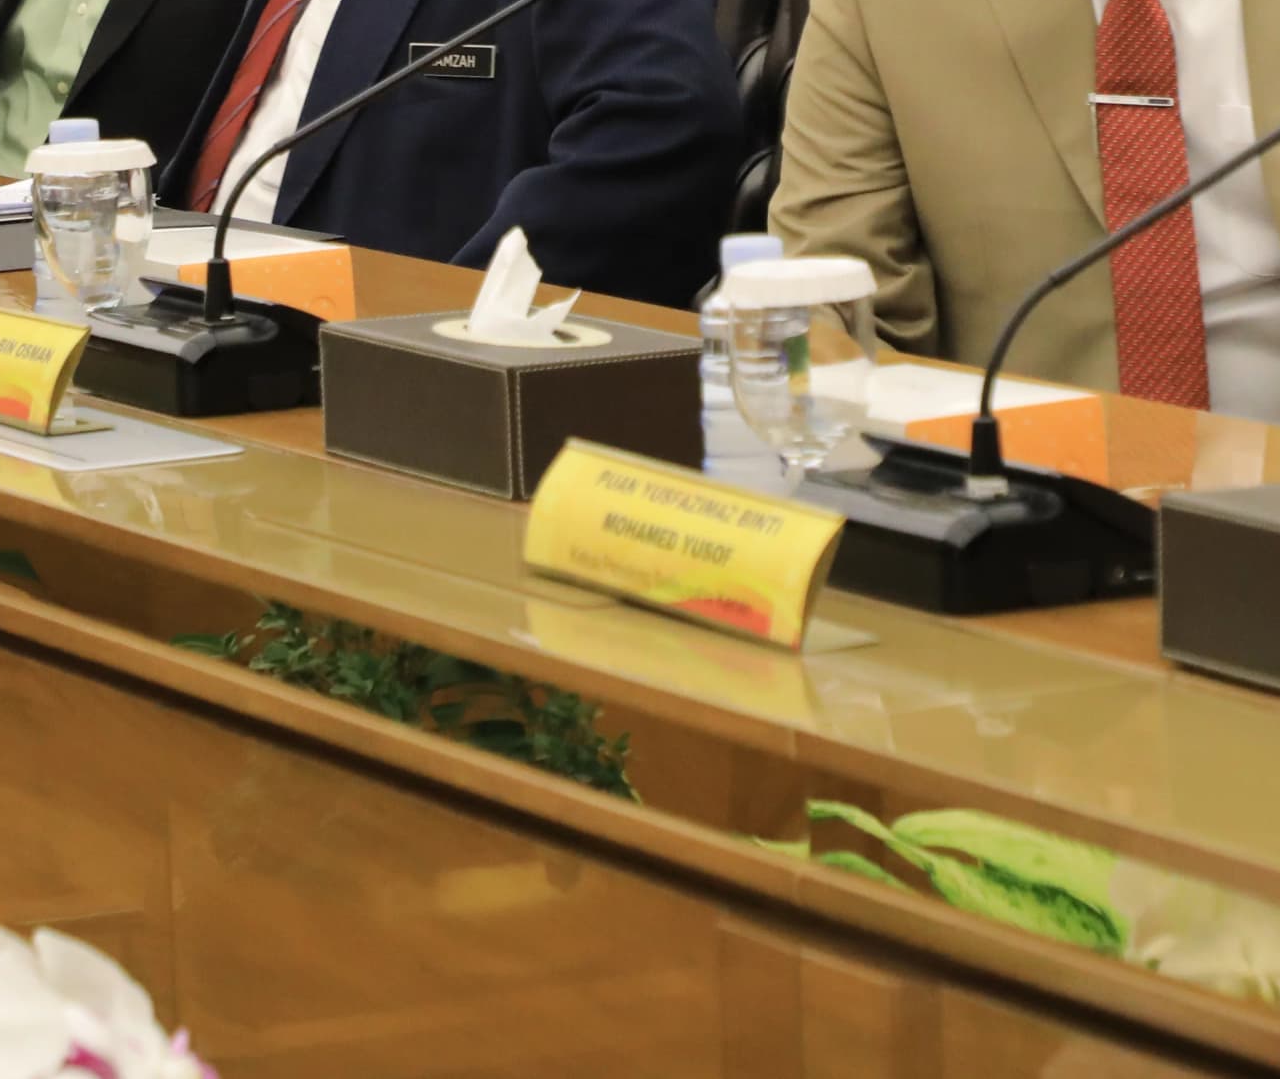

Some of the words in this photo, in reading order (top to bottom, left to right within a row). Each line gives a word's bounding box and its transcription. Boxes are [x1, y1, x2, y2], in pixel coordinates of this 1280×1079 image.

[431, 54, 476, 68] AMZAH
[15, 341, 56, 363] OSMAN
[594, 469, 637, 494] PUAN
[737, 506, 785, 536] BINTI
[601, 510, 678, 551] MOHAMED
[680, 531, 736, 568] YUSOF
